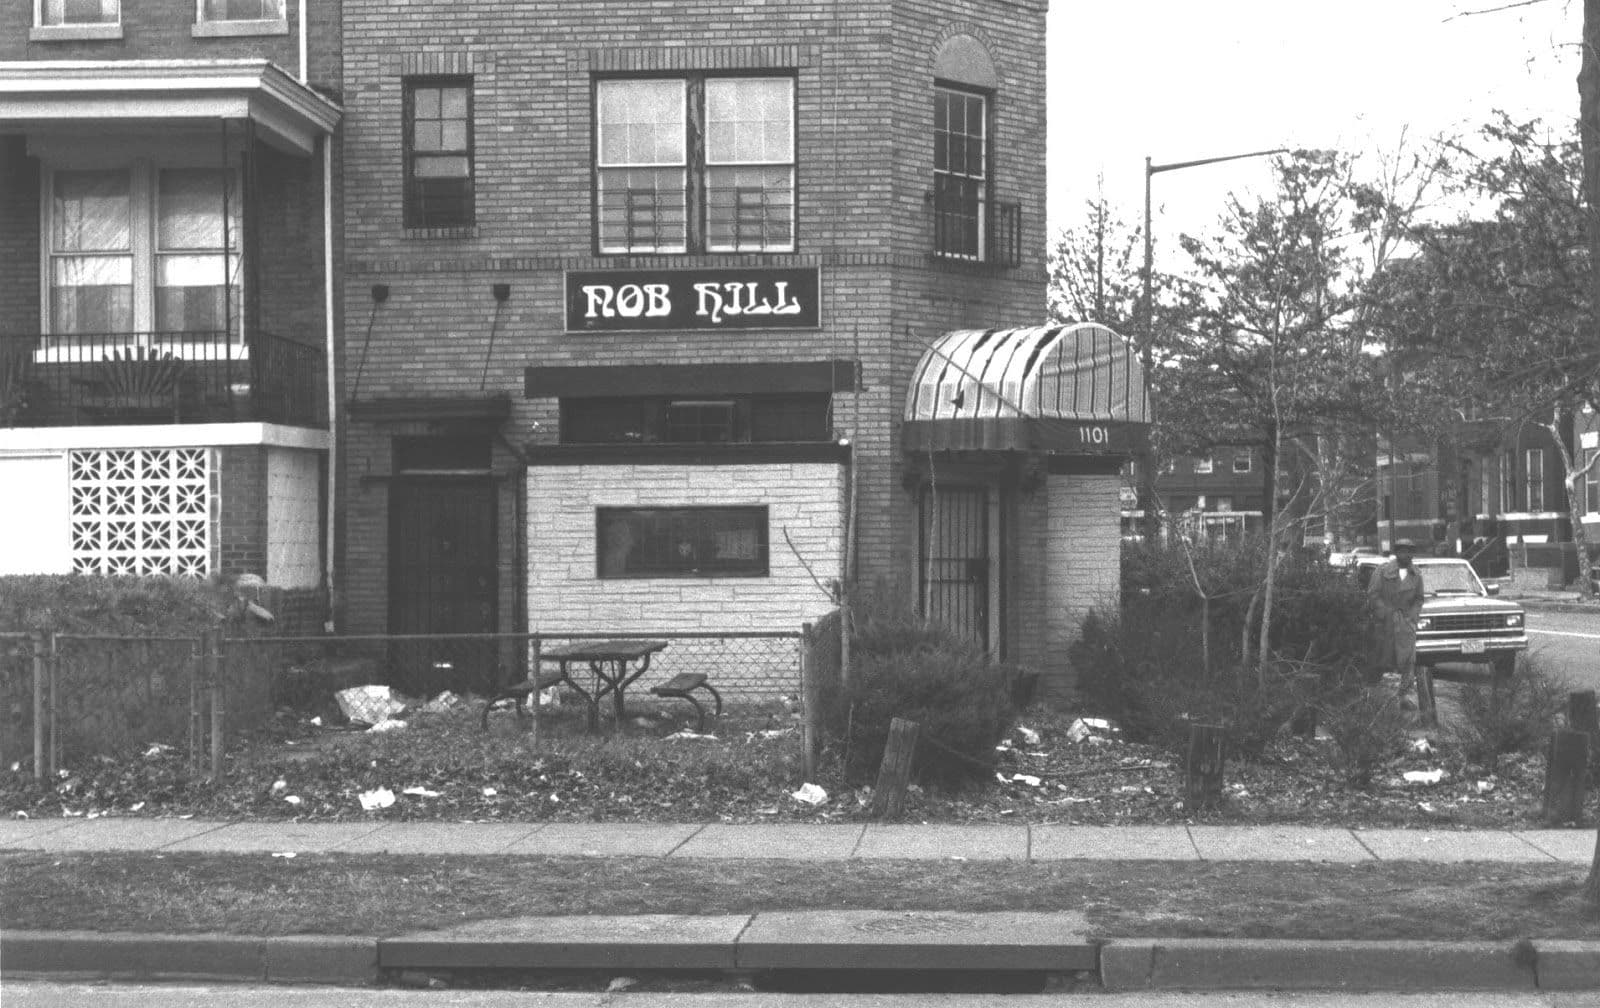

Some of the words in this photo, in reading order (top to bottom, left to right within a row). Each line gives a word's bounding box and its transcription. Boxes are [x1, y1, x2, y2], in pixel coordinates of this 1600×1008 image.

[582, 284, 672, 318] NOB
[693, 281, 801, 323] HILL
[1080, 427, 1108, 444] 1101
